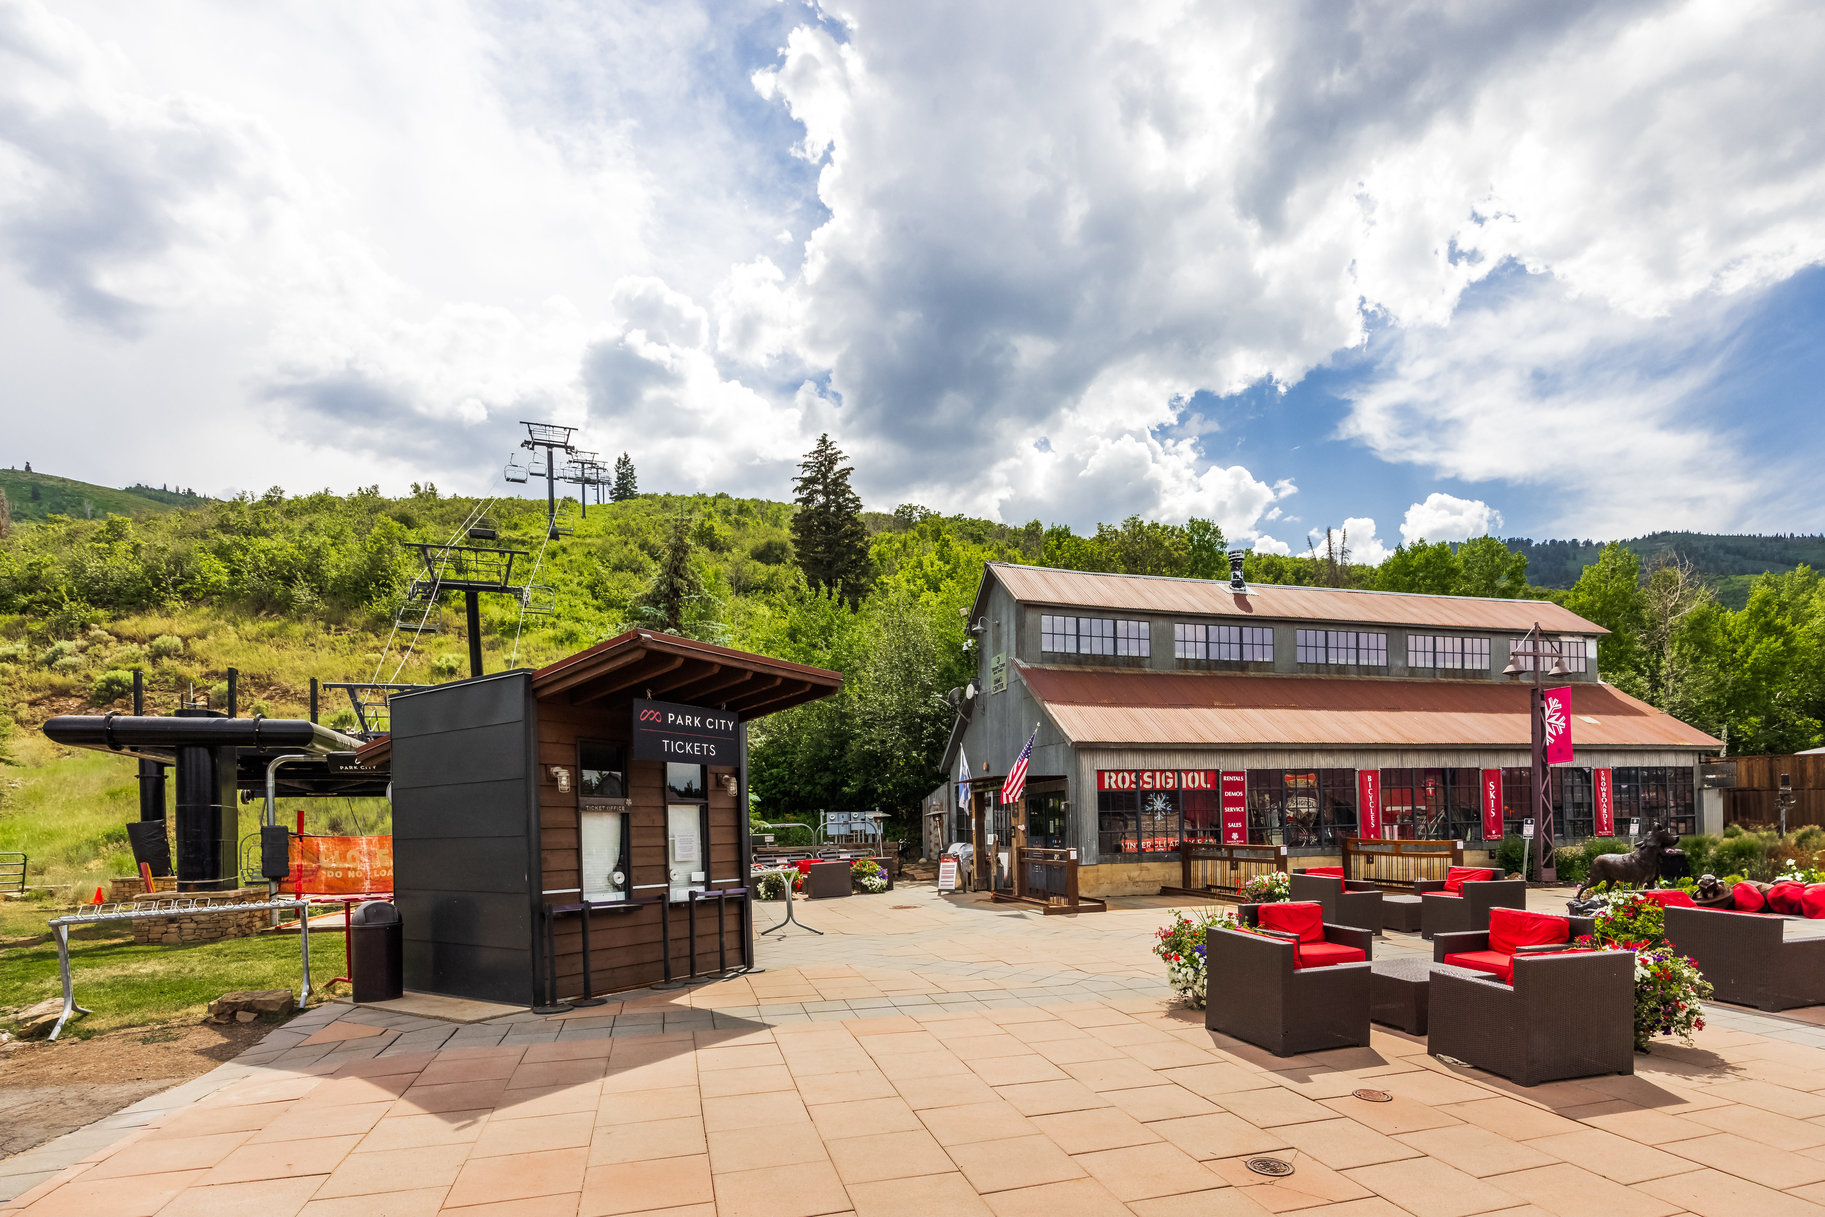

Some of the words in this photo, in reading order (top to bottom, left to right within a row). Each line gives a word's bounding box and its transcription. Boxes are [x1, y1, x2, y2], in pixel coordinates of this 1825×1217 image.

[668, 712, 701, 728] PARK
[706, 718, 734, 731] CITY
[662, 739, 716, 757] TICKETS
[1104, 771, 1211, 789] ROSSIGNOL
[1367, 775, 1375, 828] BICYCLES
[1600, 770, 1608, 825] SNOWBOARDS
[374, 869, 393, 877] LOA
